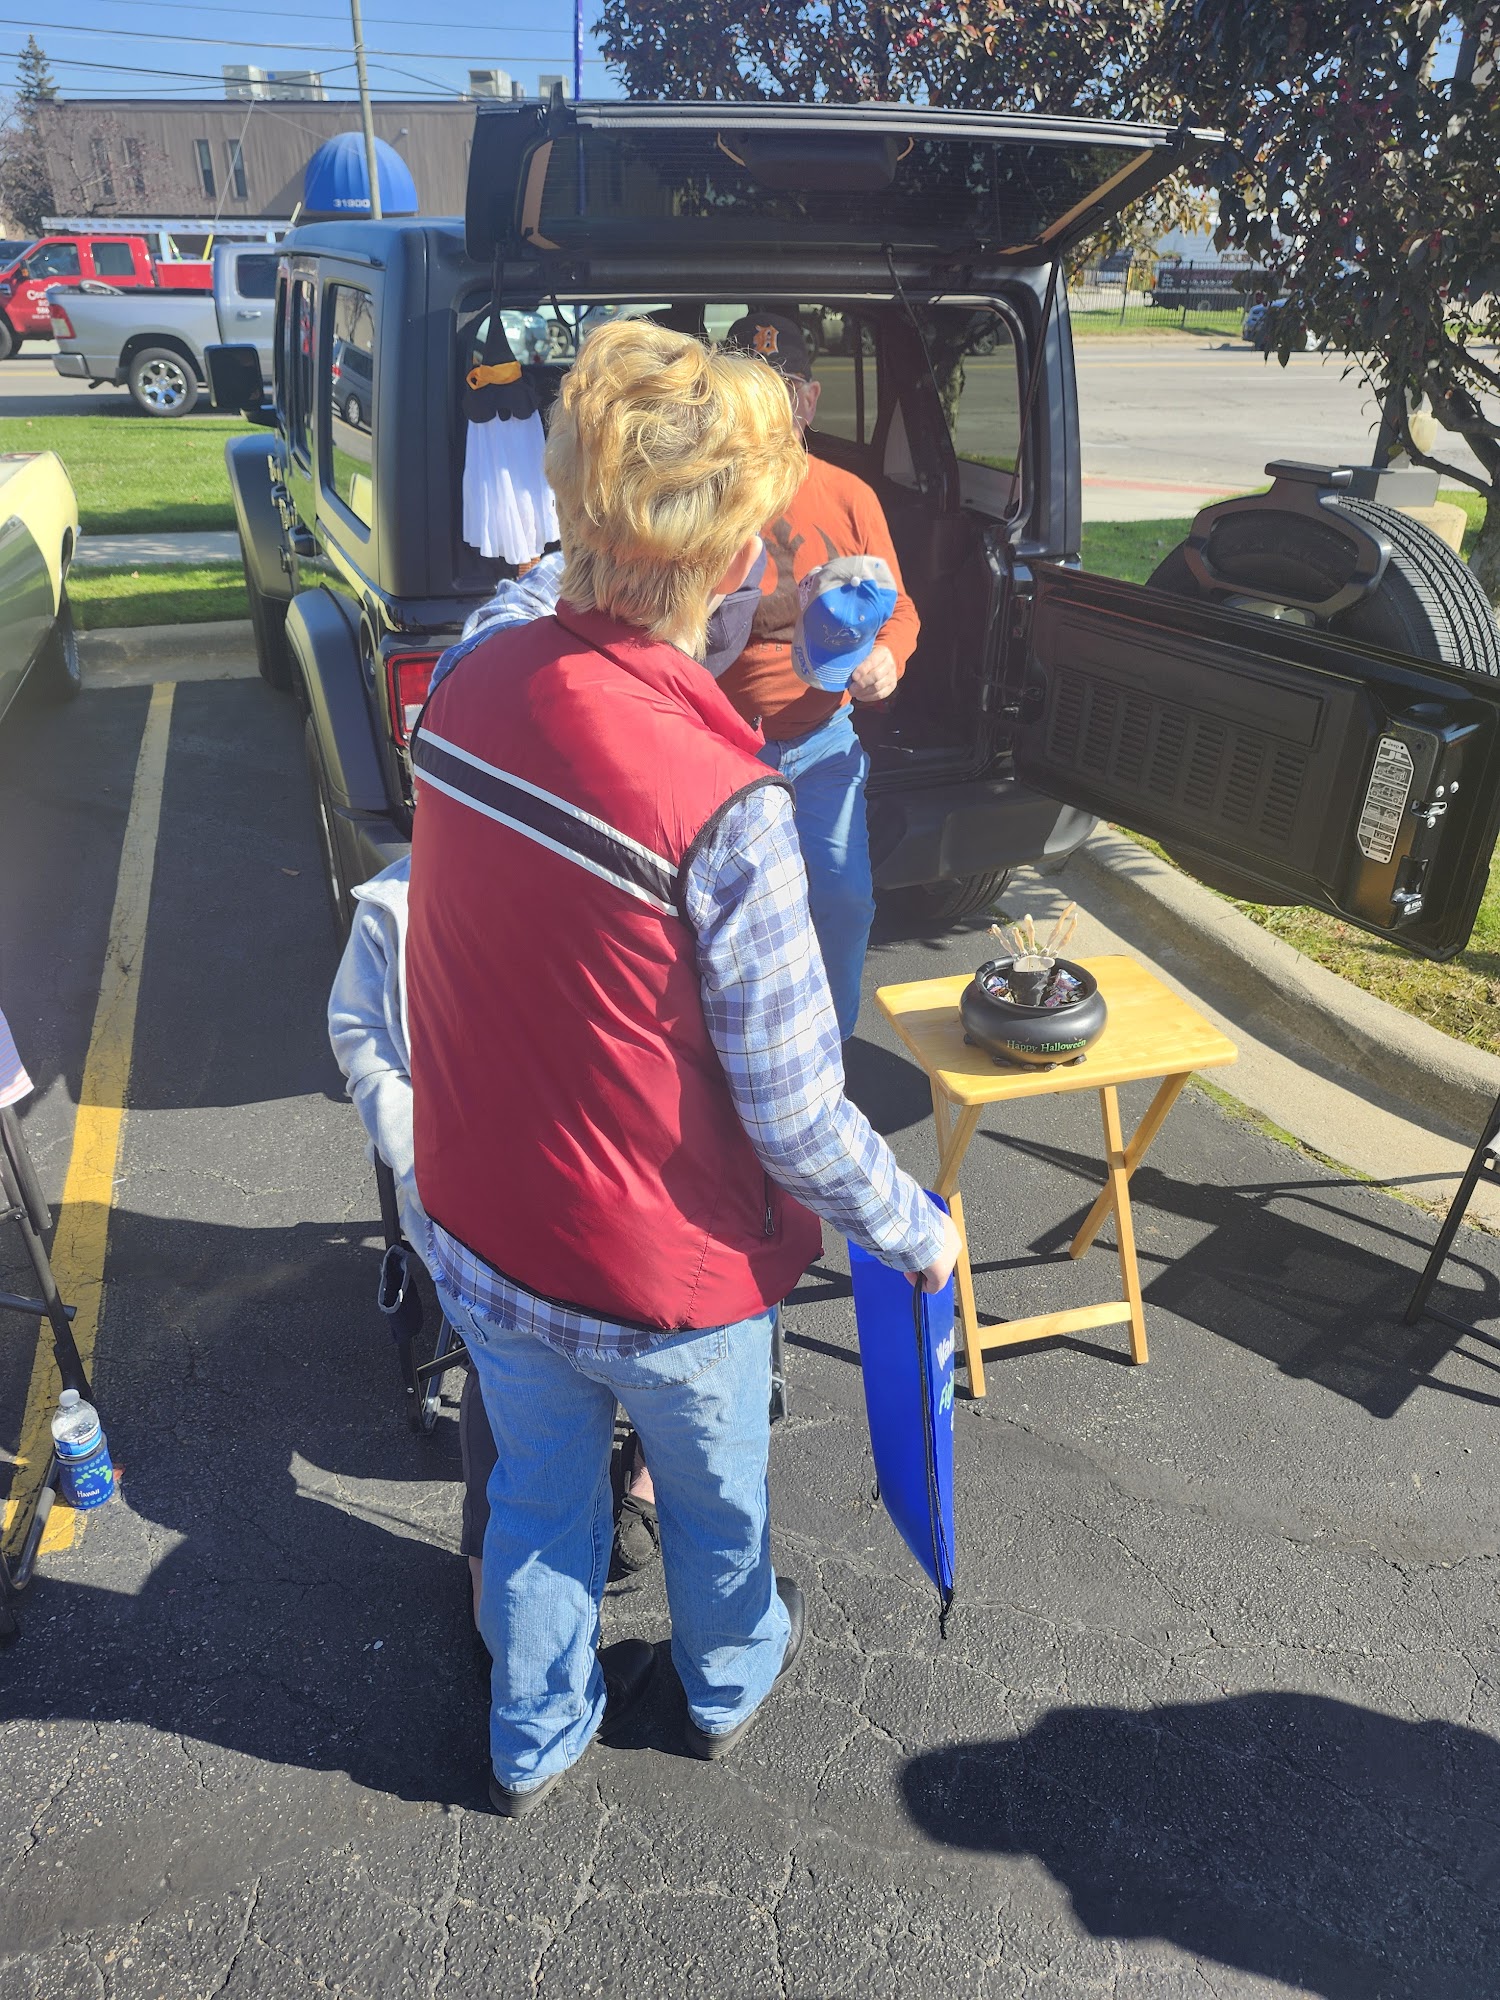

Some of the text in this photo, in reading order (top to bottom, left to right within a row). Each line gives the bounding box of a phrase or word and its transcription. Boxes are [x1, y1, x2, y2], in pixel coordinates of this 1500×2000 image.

[753, 324, 779, 357] D
[1387, 741, 1400, 750] Jeep
[1379, 750, 1410, 763] JL
[1374, 831, 1392, 843] USA
[1006, 1039, 1087, 1053] Happy Halloween
